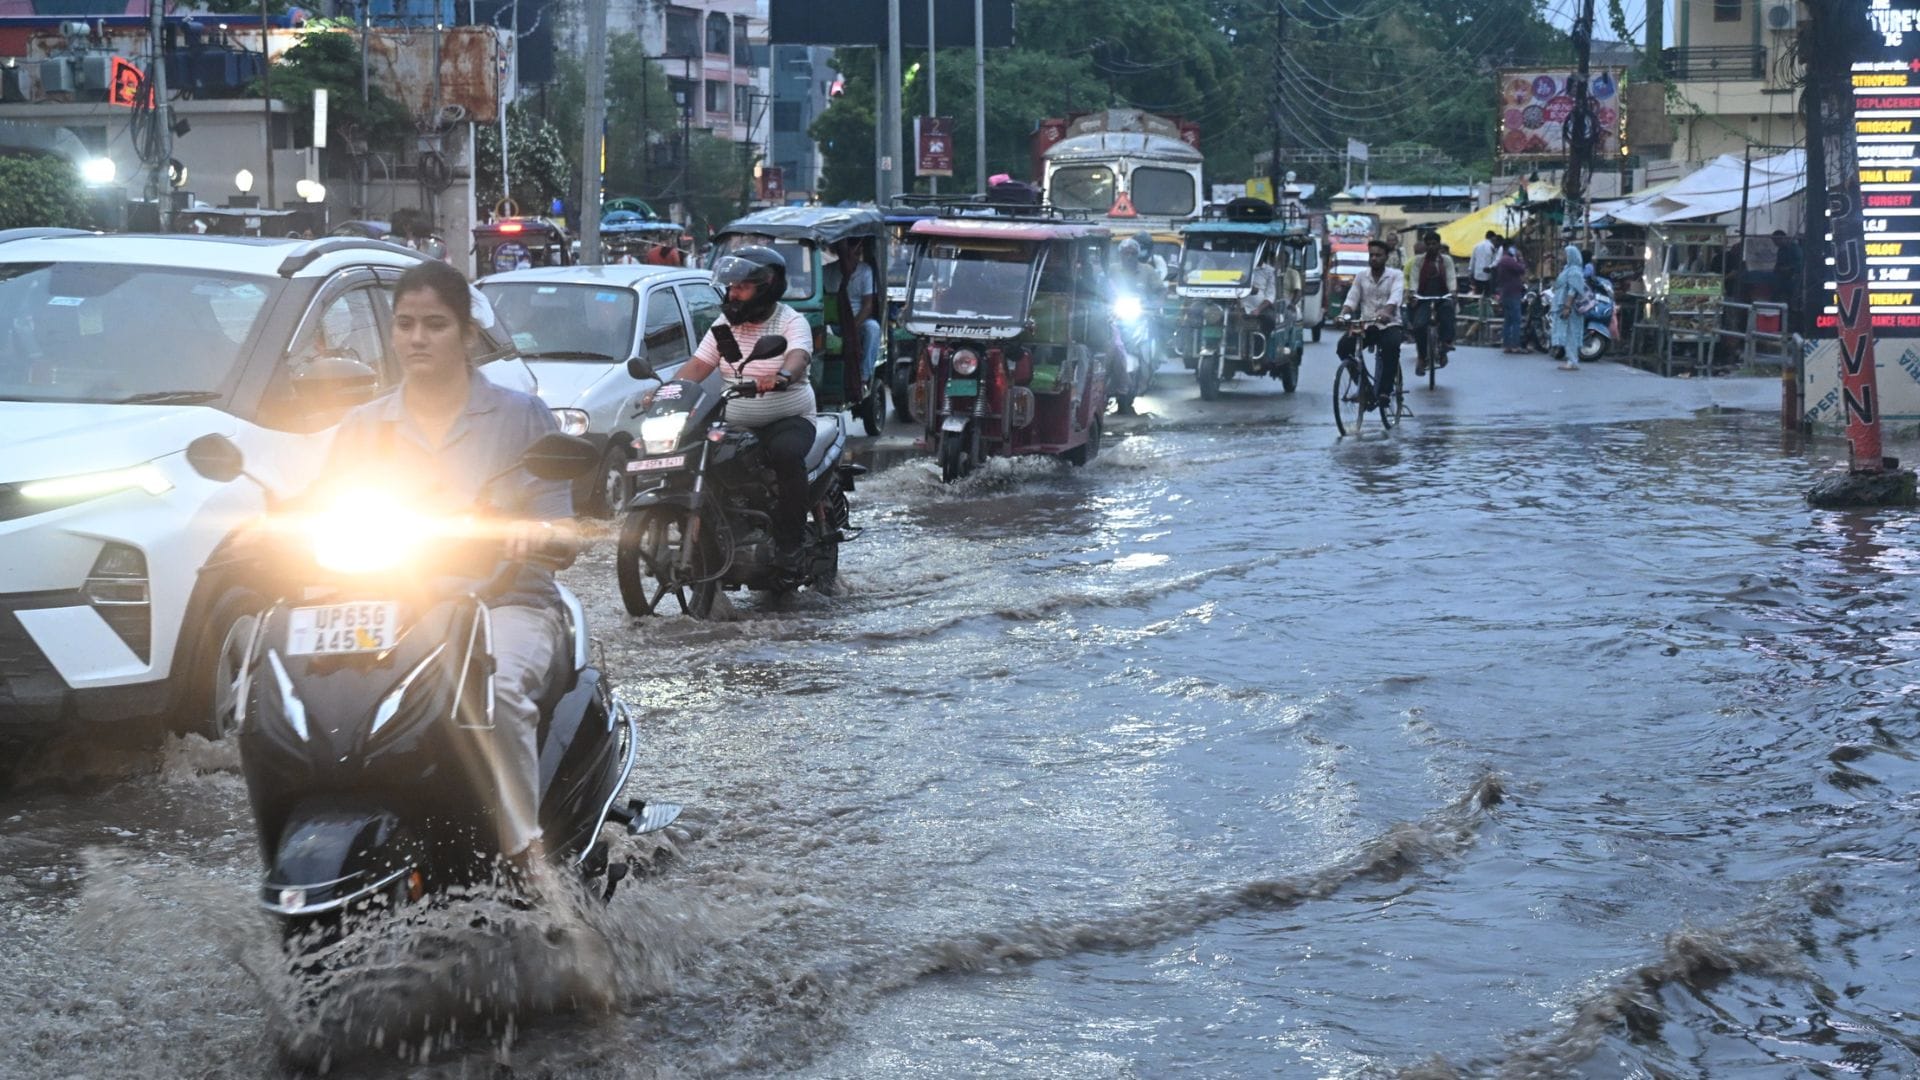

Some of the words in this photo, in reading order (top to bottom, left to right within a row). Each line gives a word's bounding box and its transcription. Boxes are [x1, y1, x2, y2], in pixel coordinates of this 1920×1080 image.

[1885, 169, 1912, 182] UNIT
[1868, 194, 1912, 207] SURGERY
[1879, 268, 1910, 281] X-RAY
[1869, 293, 1913, 305] THERAPY
